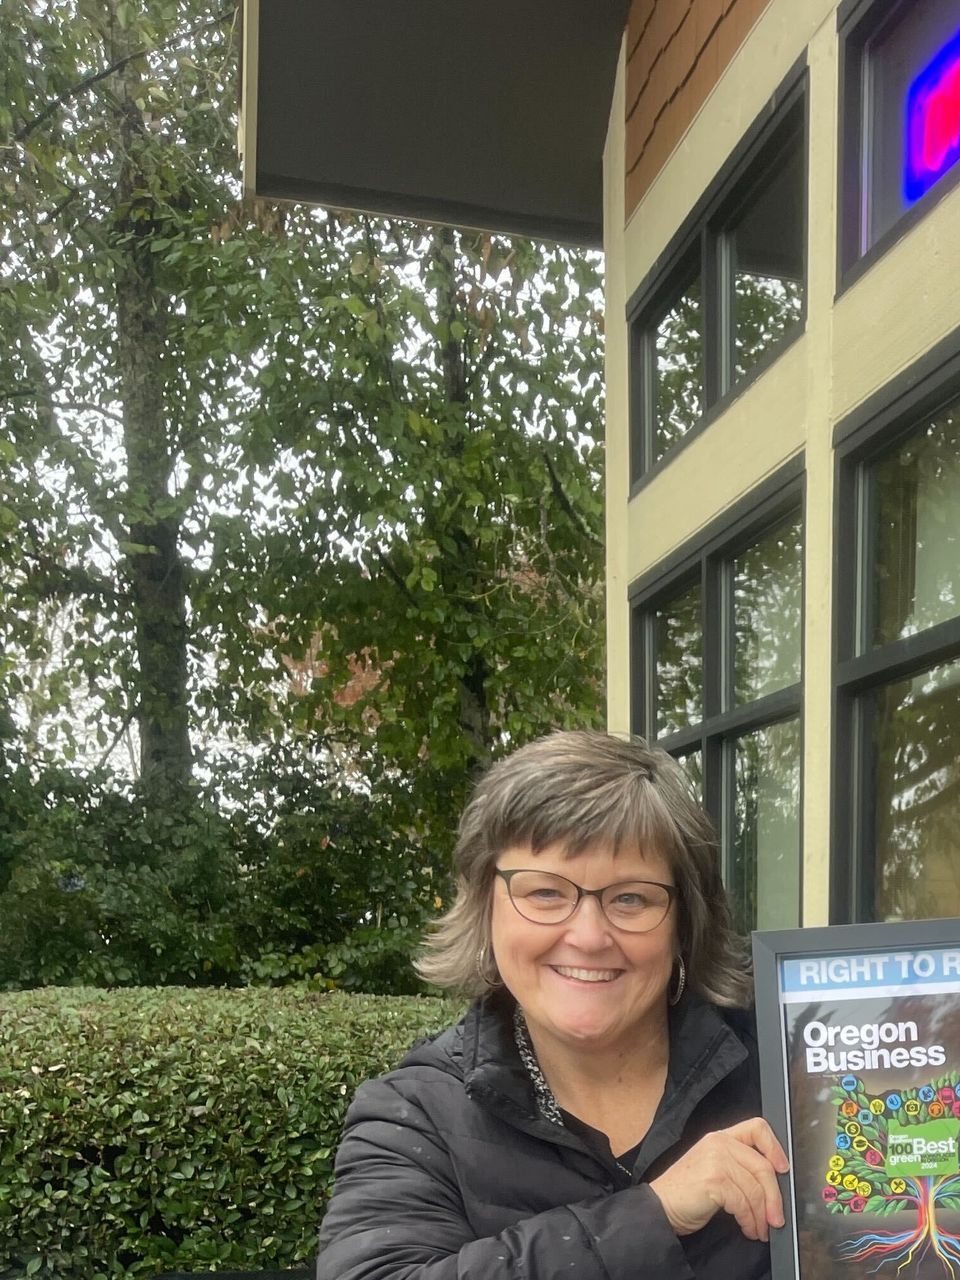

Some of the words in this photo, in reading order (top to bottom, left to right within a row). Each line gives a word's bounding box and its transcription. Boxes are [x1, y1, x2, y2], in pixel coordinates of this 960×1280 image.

[799, 956, 889, 985] RIGHT
[895, 953, 935, 979] TO
[803, 1020, 919, 1050] Oregon
[805, 1045, 946, 1073] Business
[889, 1143, 913, 1156] 100
[913, 1136, 956, 1155] Best
[889, 1154, 921, 1166] green
